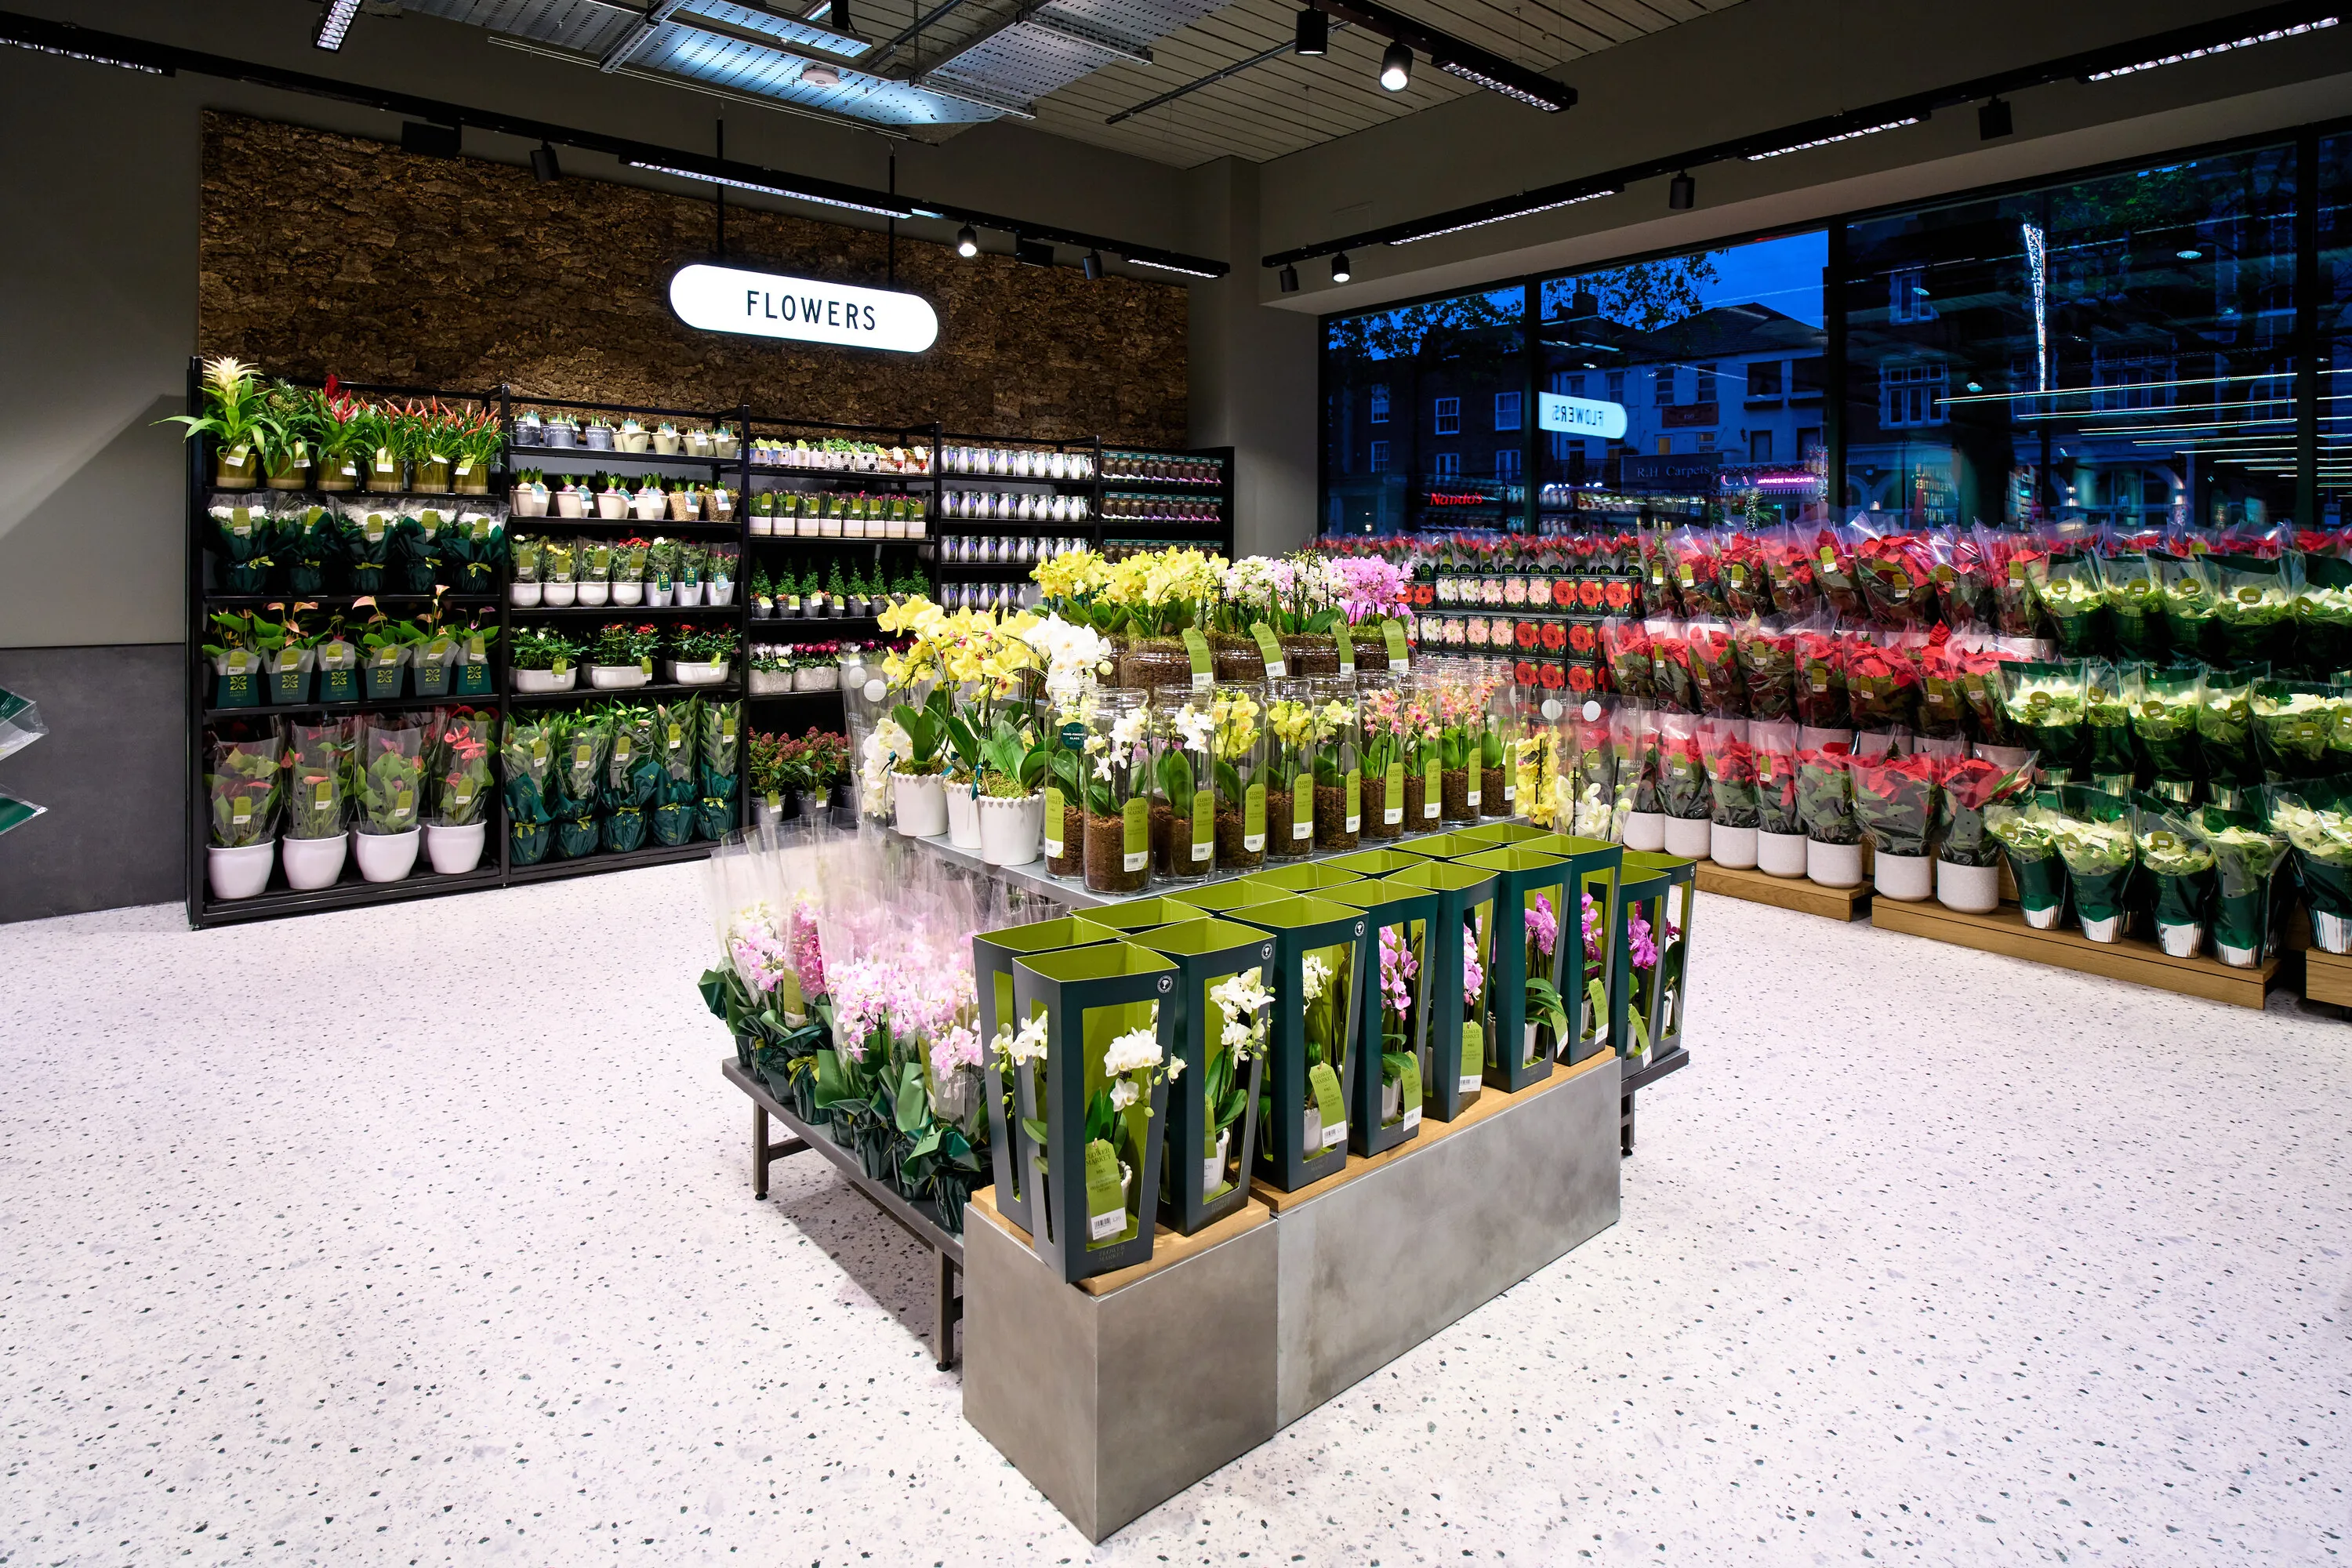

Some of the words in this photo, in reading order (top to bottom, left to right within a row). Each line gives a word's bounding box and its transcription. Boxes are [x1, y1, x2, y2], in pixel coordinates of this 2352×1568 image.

[746, 290, 877, 331] FLOWERS
[1666, 465, 1710, 479] Carpets
[1430, 492, 1483, 506] Nando's
[1312, 1069, 1333, 1080] FLOWER
[1315, 1075, 1334, 1084] MARKET
[1085, 1154, 1111, 1167] MARKET
